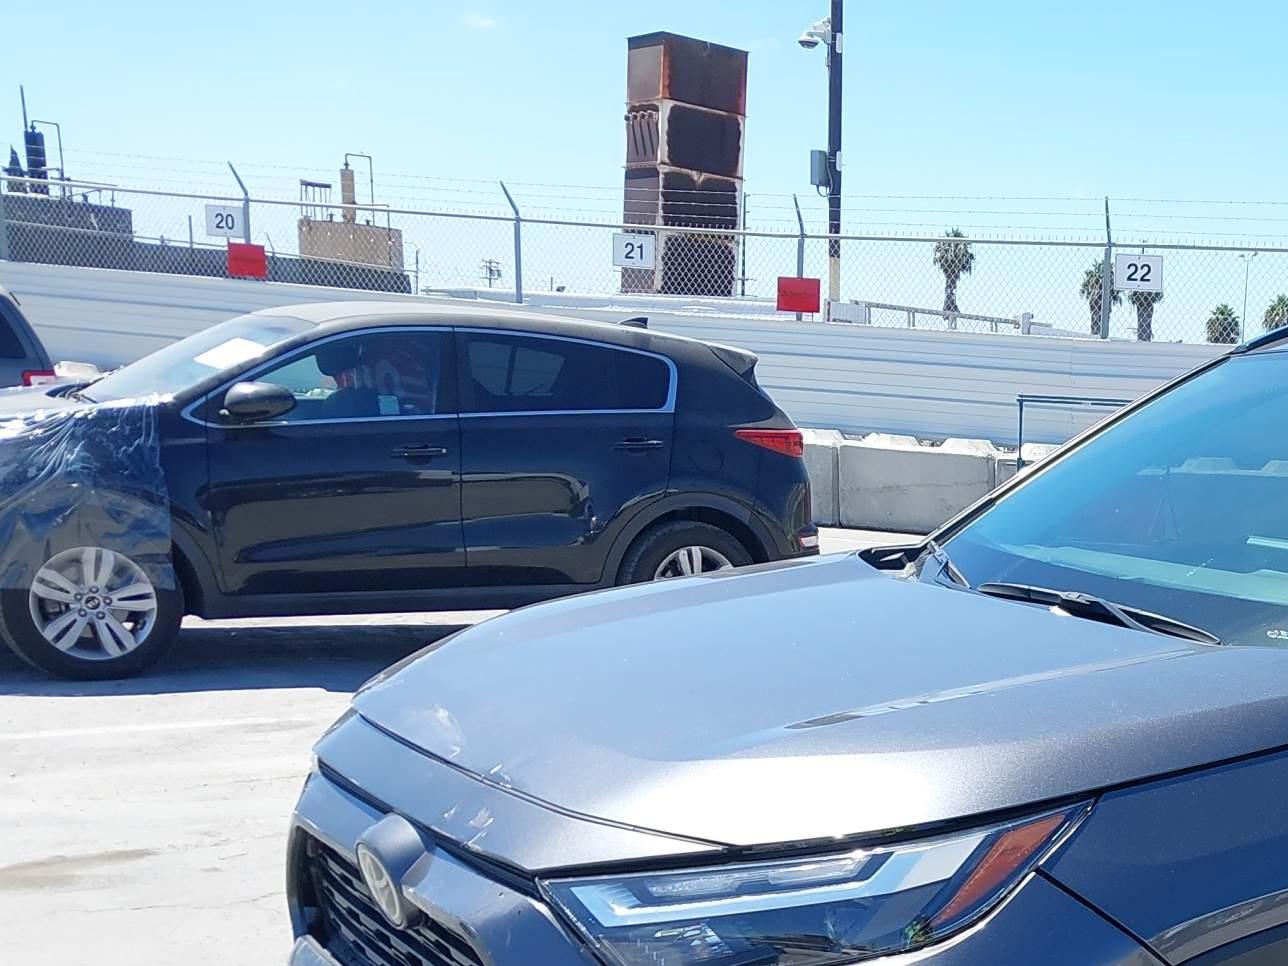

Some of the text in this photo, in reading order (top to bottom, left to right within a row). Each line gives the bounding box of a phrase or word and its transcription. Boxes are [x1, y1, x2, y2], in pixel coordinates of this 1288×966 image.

[214, 212, 235, 231] 20
[624, 242, 644, 261] 21
[1126, 262, 1152, 282] 22
